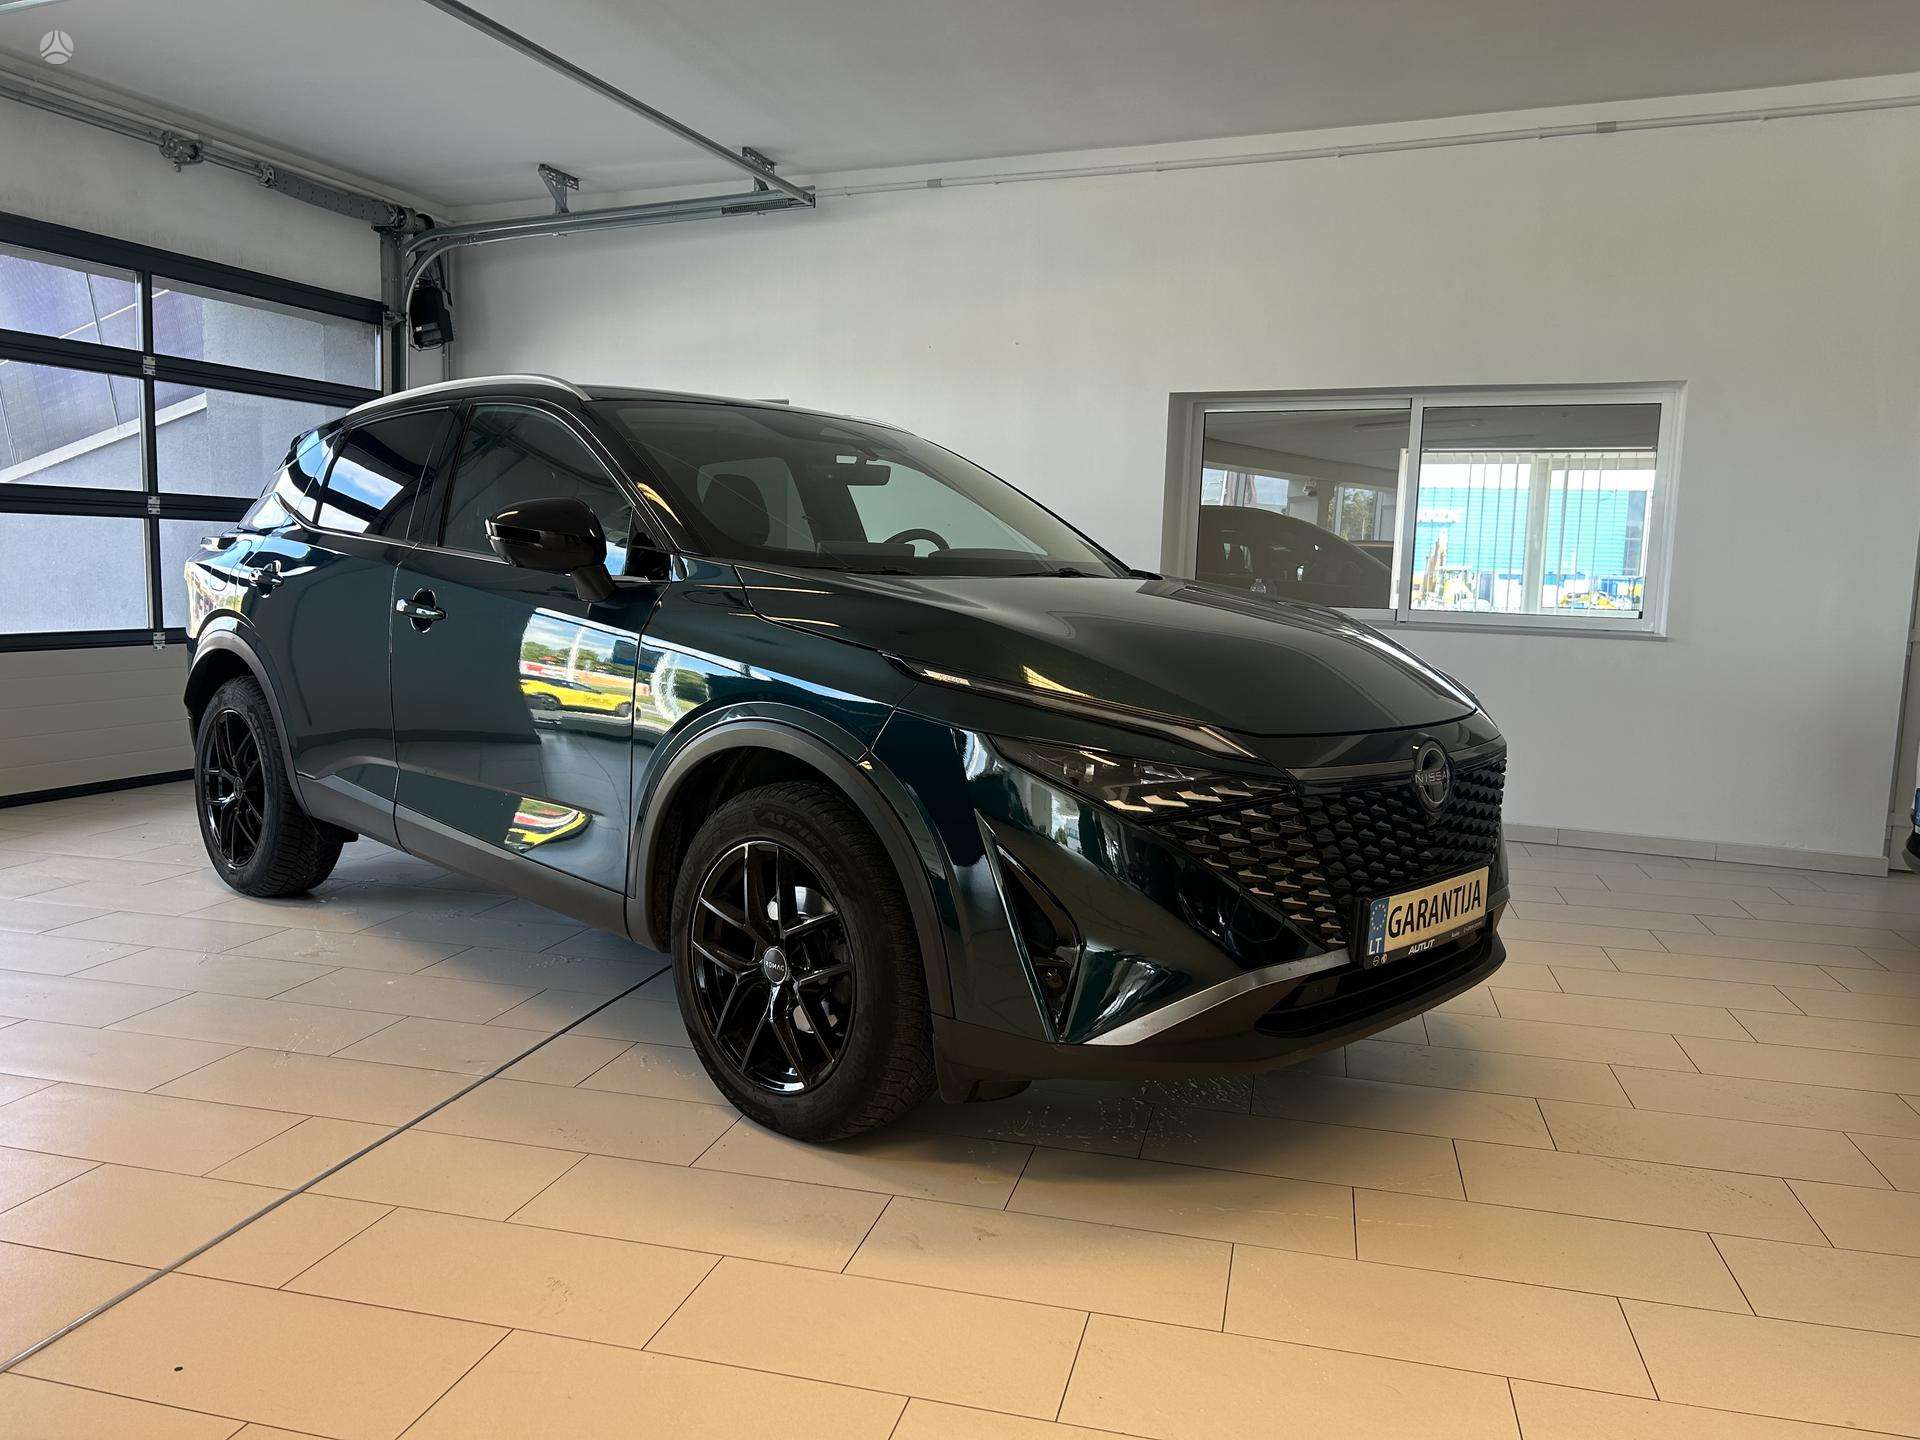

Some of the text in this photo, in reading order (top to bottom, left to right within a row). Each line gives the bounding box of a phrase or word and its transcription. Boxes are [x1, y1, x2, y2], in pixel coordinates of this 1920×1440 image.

[1414, 768, 1449, 784] NISSA
[1387, 879, 1481, 938] GARANTIJA
[1368, 937, 1383, 956] LT
